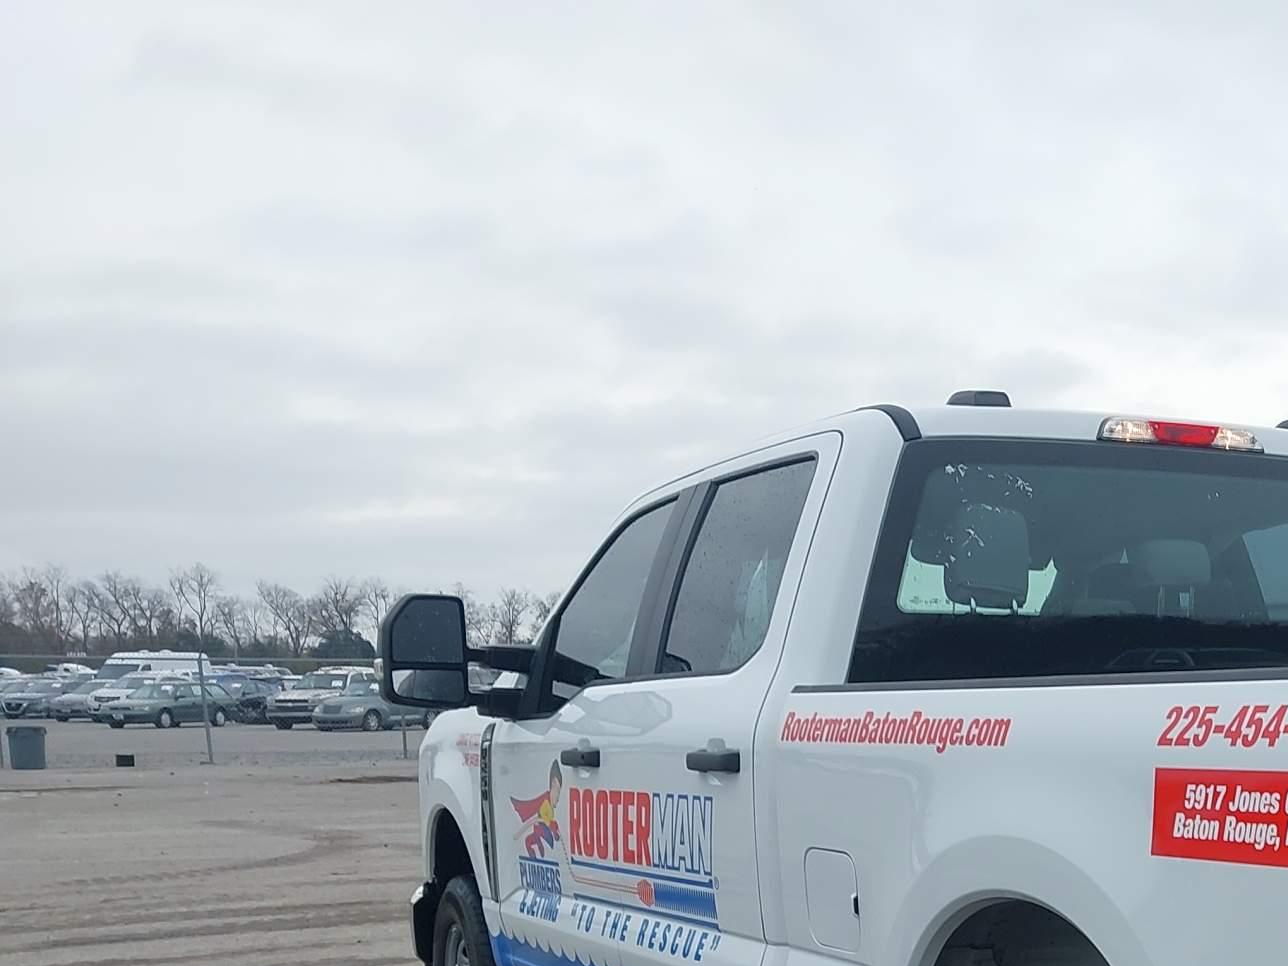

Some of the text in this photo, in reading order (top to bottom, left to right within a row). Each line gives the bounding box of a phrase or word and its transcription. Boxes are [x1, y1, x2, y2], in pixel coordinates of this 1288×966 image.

[780, 711, 1012, 754] RootermanBatonRouge.com
[1184, 783, 1226, 811] 5917
[1228, 785, 1280, 816] Jones
[569, 787, 713, 876] ROOTERMAN
[1172, 812, 1219, 842] Baton
[1223, 817, 1280, 851] Rouge,
[519, 862, 562, 894] PLUMBERS
[526, 890, 561, 923] JETTING
[601, 910, 631, 942] THE
